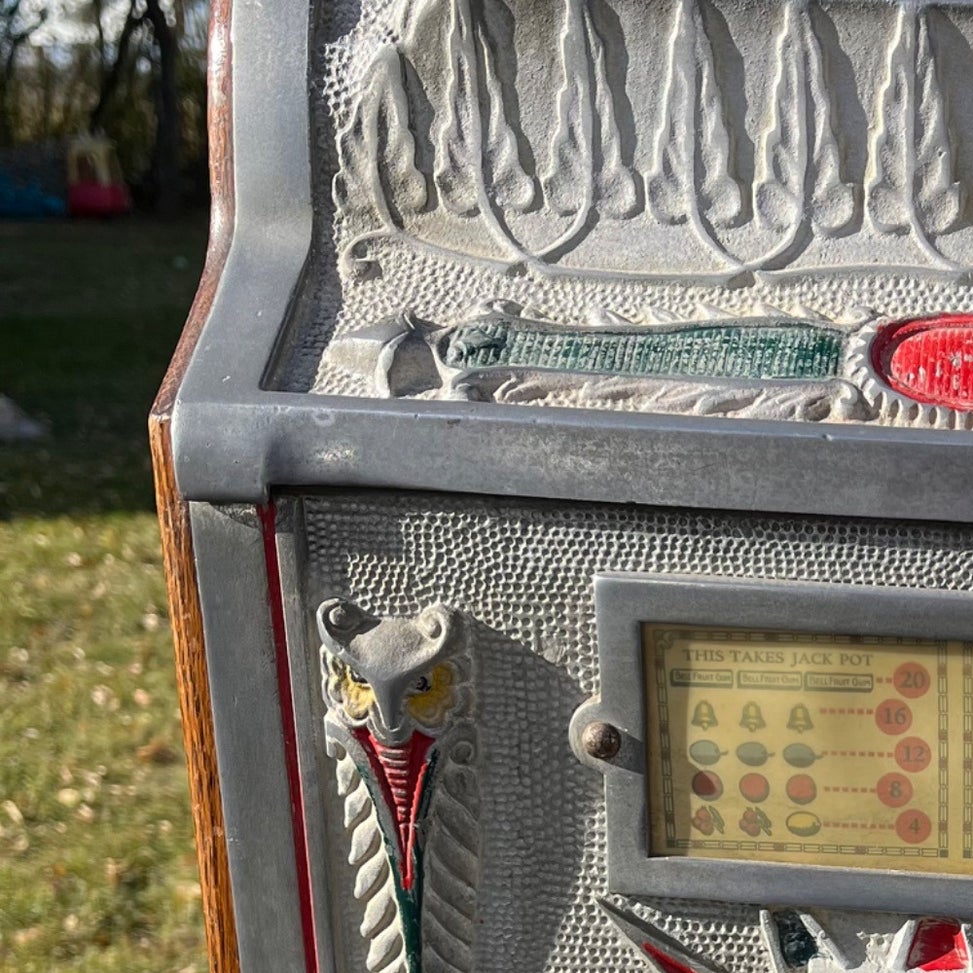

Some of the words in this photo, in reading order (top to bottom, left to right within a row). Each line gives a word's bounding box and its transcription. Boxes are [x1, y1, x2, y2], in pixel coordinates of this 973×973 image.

[682, 649, 725, 662] THIS
[729, 649, 785, 664] TAKES
[790, 652, 833, 667] JACK
[840, 653, 874, 666] POT
[900, 671, 925, 688] 20
[883, 707, 906, 725] 16
[903, 746, 925, 763] 12
[889, 780, 901, 798] 8
[908, 817, 920, 834] 4
